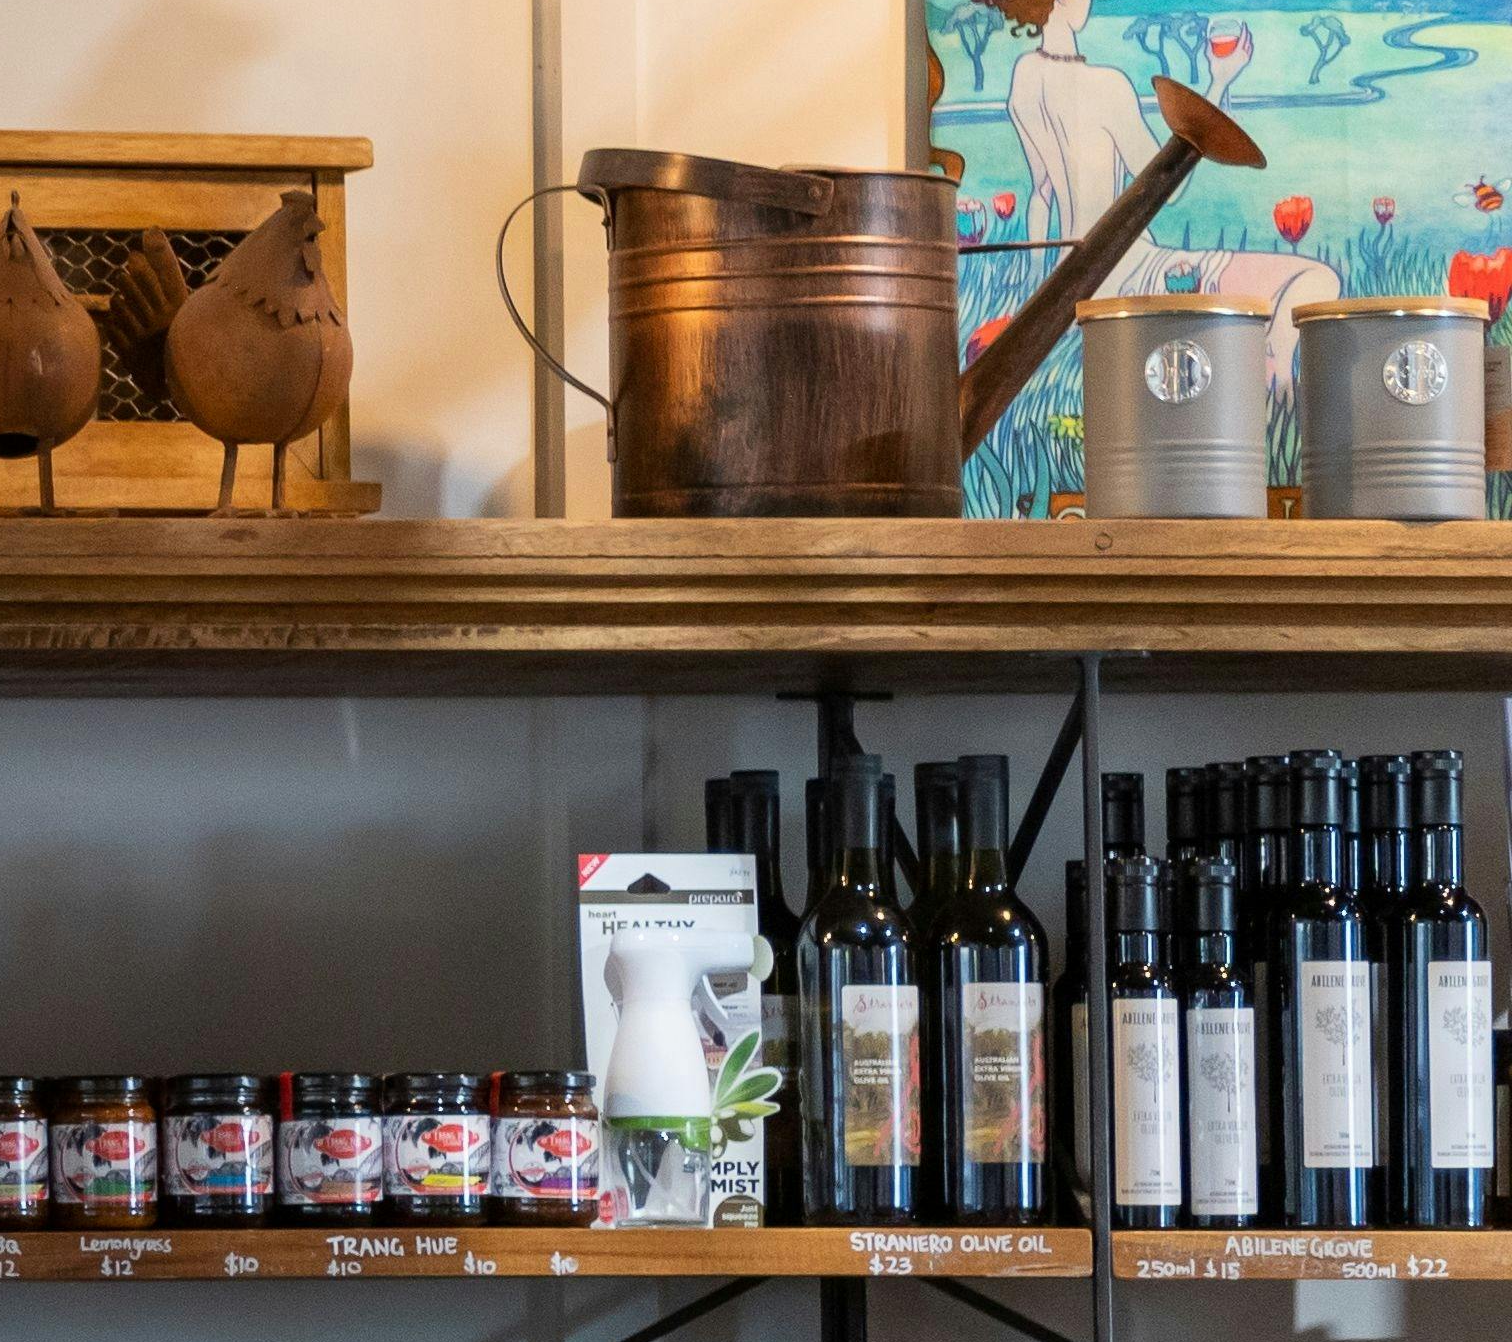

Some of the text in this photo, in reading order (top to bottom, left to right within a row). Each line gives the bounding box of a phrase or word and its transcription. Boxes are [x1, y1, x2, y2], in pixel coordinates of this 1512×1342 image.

[588, 911, 617, 919] heart
[80, 1236, 172, 1259] Lemongrass
[327, 1236, 458, 1258] TRANG HUE
[850, 1234, 1052, 1253] STRANIERO OLIVE OIL
[1225, 1238, 1372, 1257] ABILENE GROVE
[100, 1256, 134, 1276] $12
[870, 1255, 913, 1274] $23
[1137, 1260, 1196, 1277] 250ml
[1341, 1255, 1449, 1277] 500ml $22
